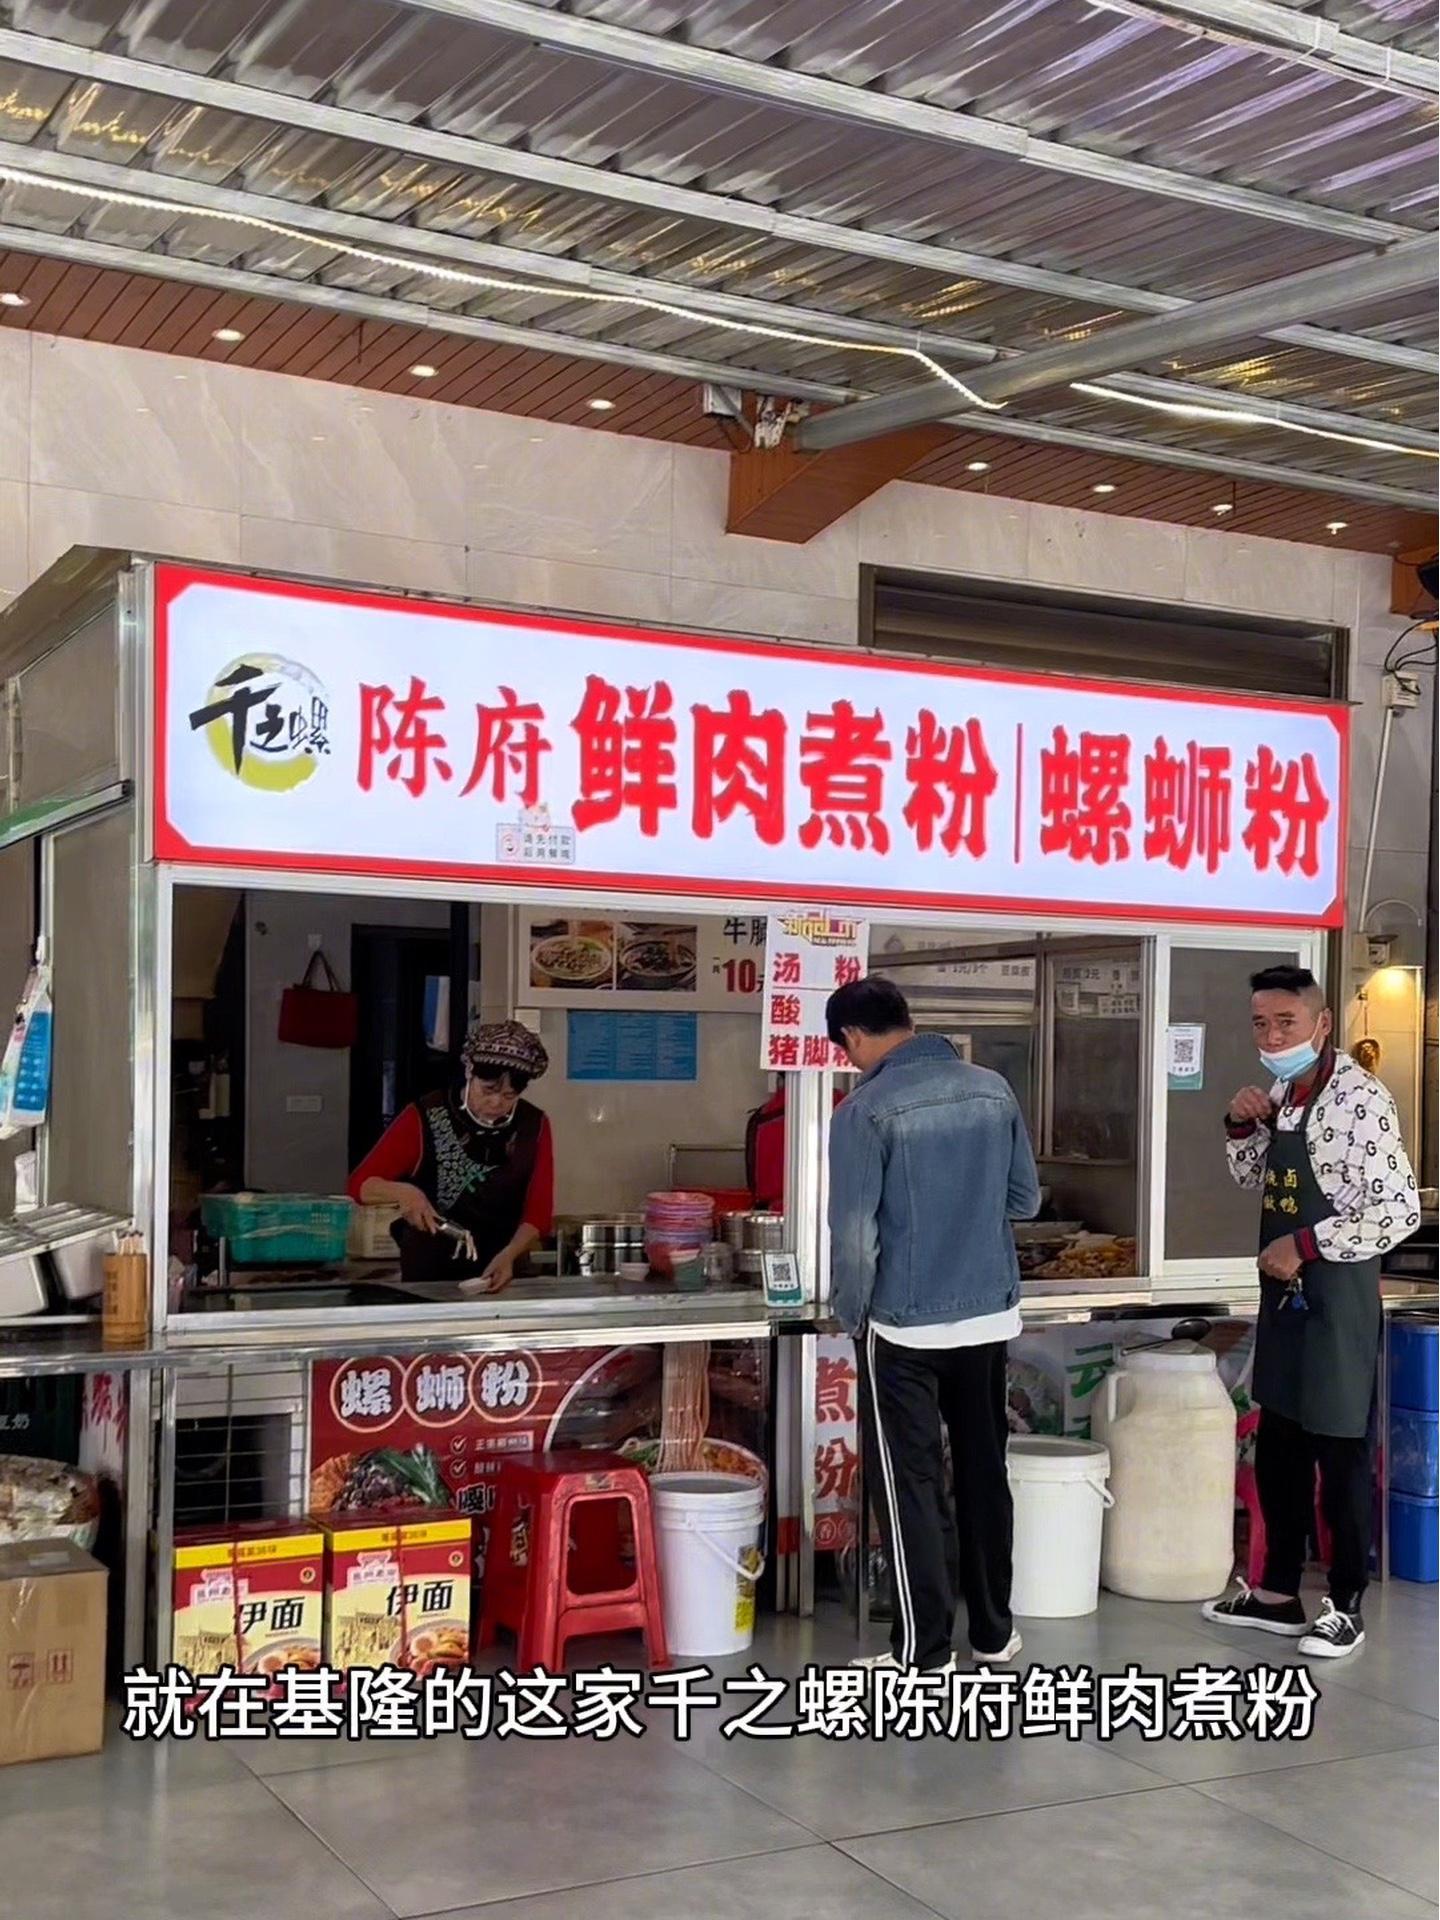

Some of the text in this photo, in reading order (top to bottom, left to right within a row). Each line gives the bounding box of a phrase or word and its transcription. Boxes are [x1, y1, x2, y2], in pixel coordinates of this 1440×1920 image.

[188, 663, 331, 774] 千之螺
[356, 673, 1331, 878] 陈府鲜肉煮粉 螺蛳粉
[340, 1360, 530, 1419] 螺蛳粉
[386, 1578, 456, 1617] 伊面
